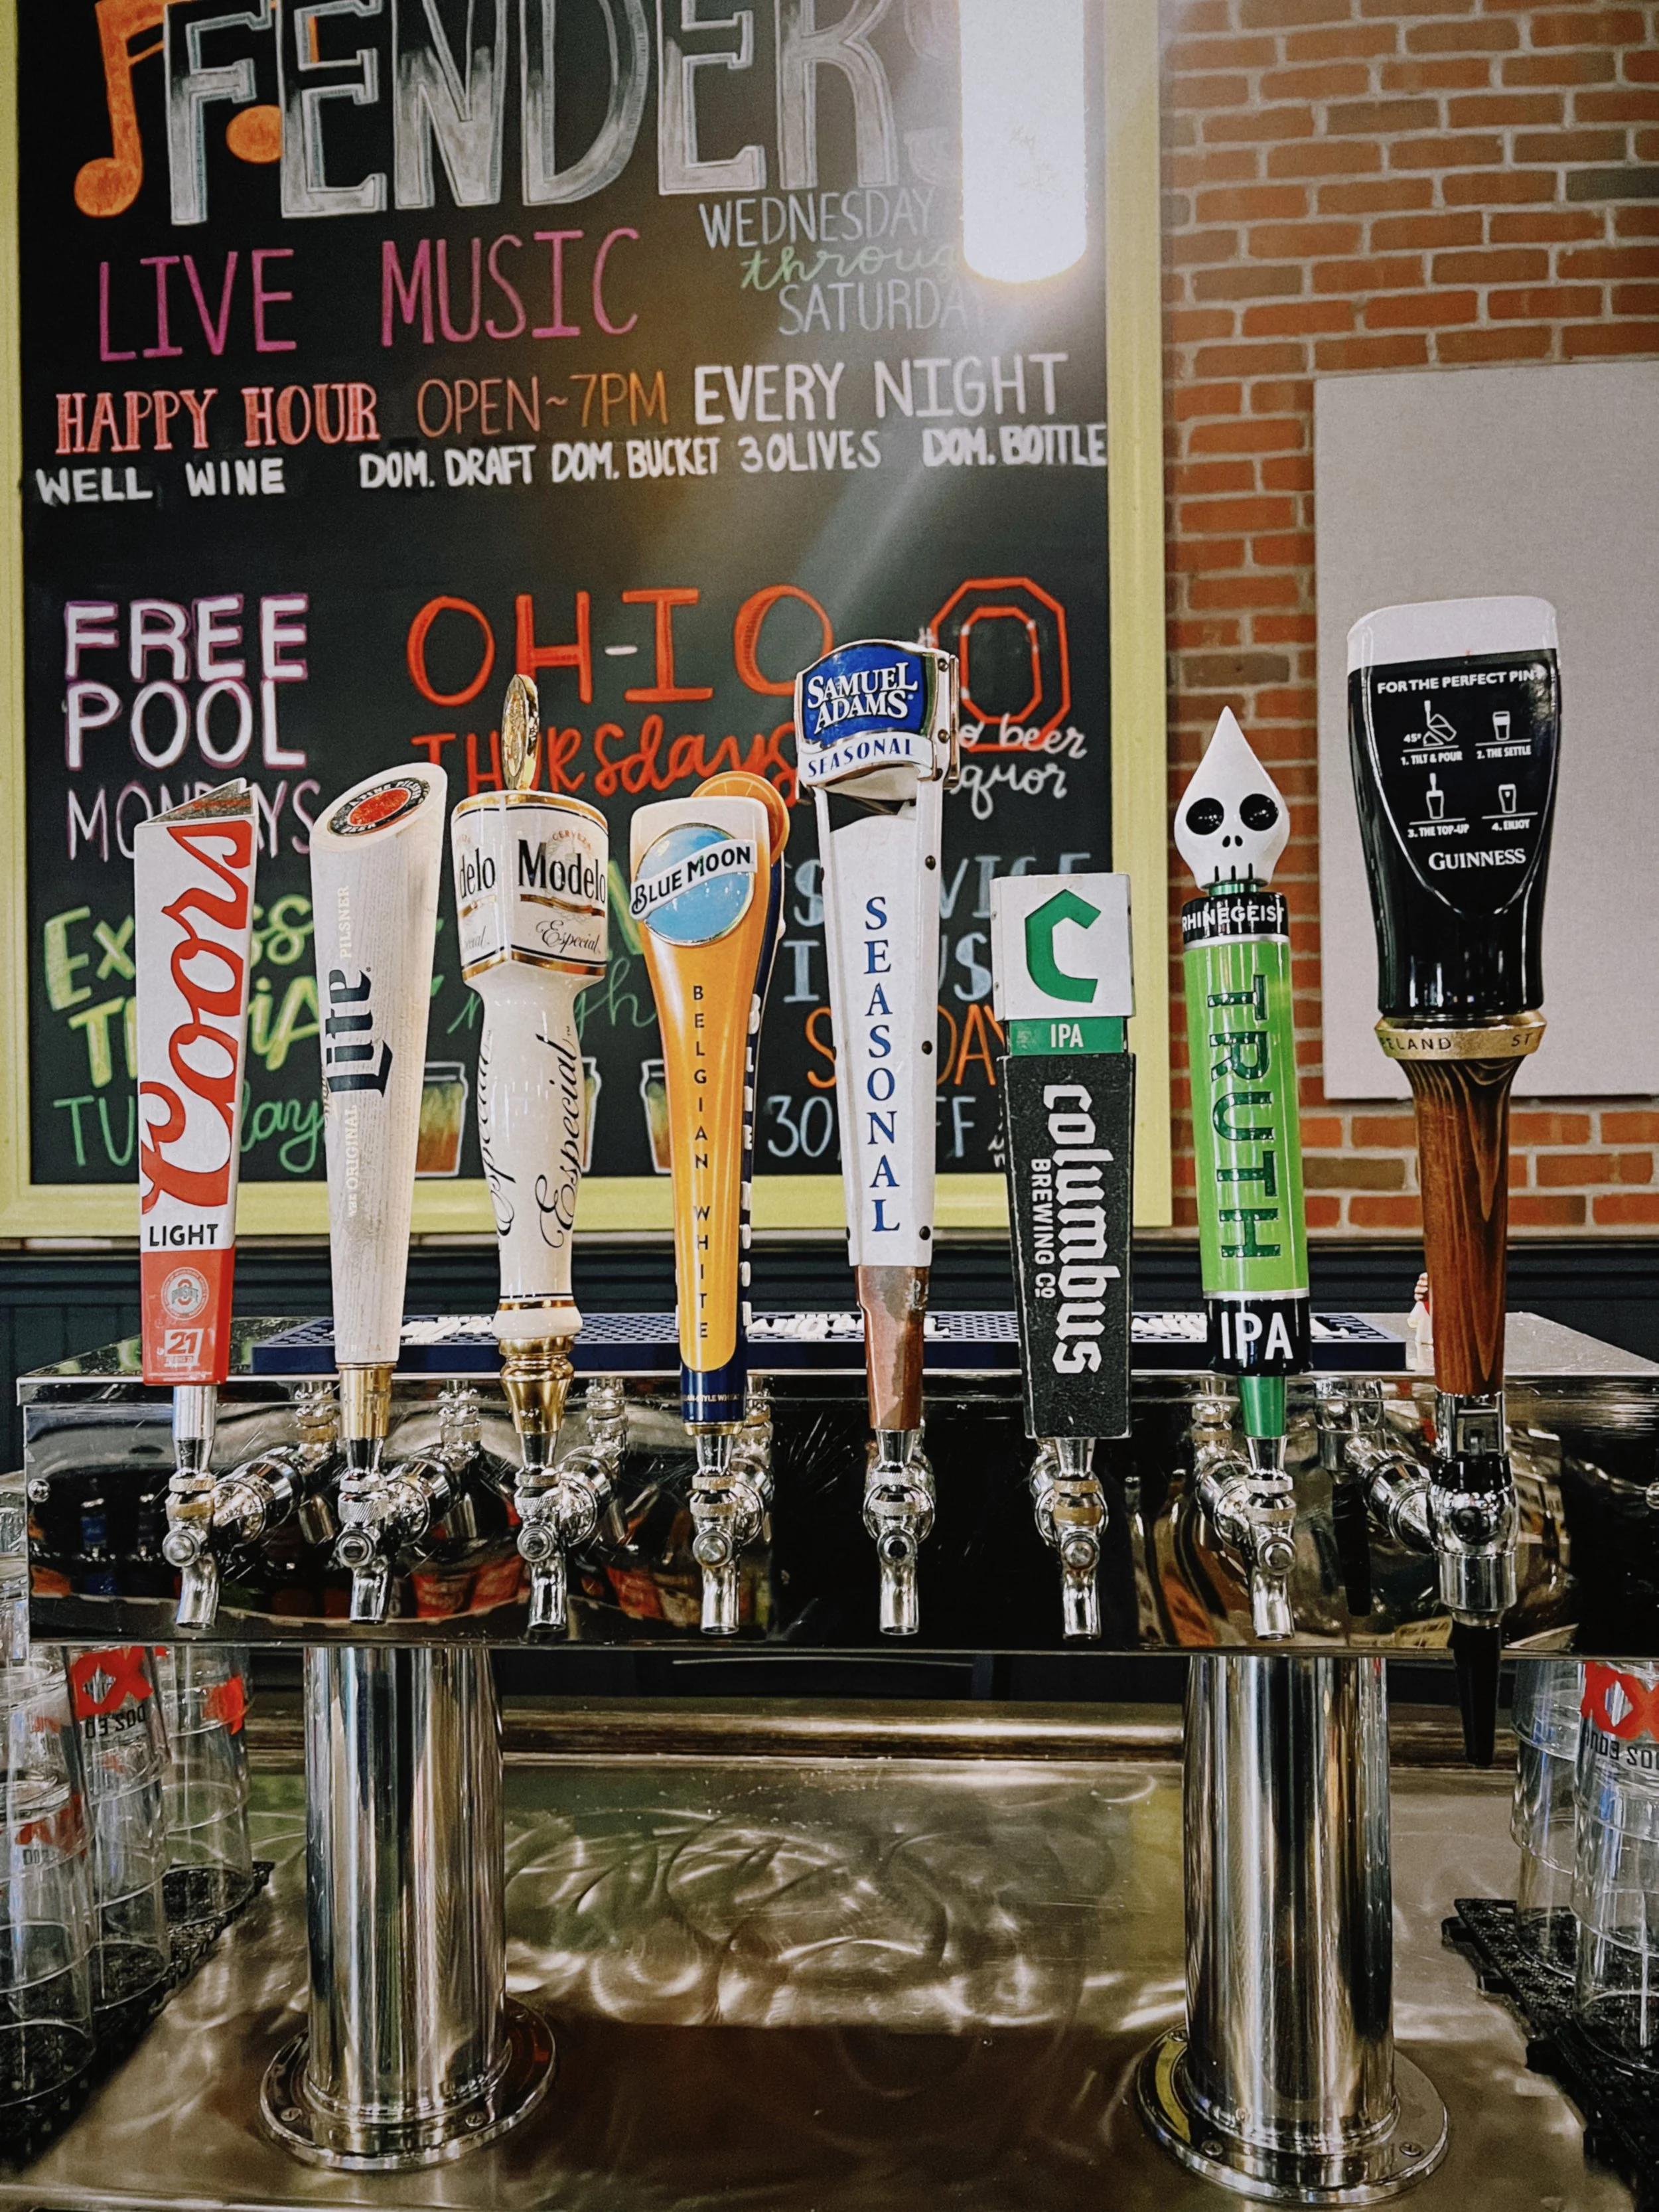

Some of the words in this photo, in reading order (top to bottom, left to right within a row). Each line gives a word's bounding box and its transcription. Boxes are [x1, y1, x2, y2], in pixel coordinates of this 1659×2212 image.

[699, 187, 937, 249] WEDNESDAY
[100, 248, 297, 362] LIVE
[380, 228, 640, 348] MUSIC
[778, 277, 975, 335] SATURDA
[56, 388, 218, 455] HAPPY
[243, 382, 380, 447] HOUR
[694, 362, 845, 425] EVERY
[875, 353, 1068, 418] NIGHT
[36, 469, 152, 504] WELL
[186, 459, 285, 496] WINE
[359, 450, 435, 490] DOM.
[445, 445, 536, 485] DRAFT
[551, 441, 619, 482] DOM.
[626, 437, 719, 479] BUCKET
[922, 428, 995, 467] DOM.
[999, 423, 1108, 466] BOTTLE
[64, 593, 308, 682] FREE
[807, 662, 918, 709] SAMUEL
[813, 688, 908, 735] ADAMS
[1377, 682, 1407, 694] FOR
[1407, 678, 1439, 690] THE
[1442, 671, 1507, 688] PERFECT
[64, 678, 307, 770] POOL
[999, 711, 1088, 759] beer
[1477, 749, 1486, 760] 2.
[1486, 748, 1502, 759] THE
[1504, 745, 1532, 757] SETTLE
[808, 737, 914, 778] SEASONAL
[1411, 753, 1428, 764] TILT
[1437, 751, 1463, 763] POUR
[950, 763, 1068, 820] quor
[1407, 828, 1418, 838] 3.
[1419, 826, 1435, 837] THE
[1436, 823, 1470, 836] TOP-UP
[1503, 818, 1530, 830] ENJOY
[518, 839, 606, 904] Modelo
[631, 871, 682, 916] BLUE
[686, 845, 752, 881] MOON
[1428, 848, 1526, 870] GUINNESS
[339, 884, 350, 960] PILSNER
[535, 919, 599, 954] Especial
[1182, 905, 1285, 932] RHINEGEIST
[140, 819, 253, 1215] Coors
[325, 969, 395, 1098] Lite
[1050, 1023, 1084, 1049] IPA
[693, 985, 708, 1171] BELGIAN
[863, 896, 901, 1232] SEASONAL
[535, 1033, 582, 1248] Especial
[1207, 974, 1281, 1258] TRUTH
[346, 1104, 358, 1195] ORIGINAL
[149, 1224, 219, 1247] LIGHT
[1030, 1157, 1055, 1265] BREWING
[693, 1205, 711, 1339] WHITE
[167, 1331, 198, 1355] 21
[1220, 1311, 1294, 1362] IPA
